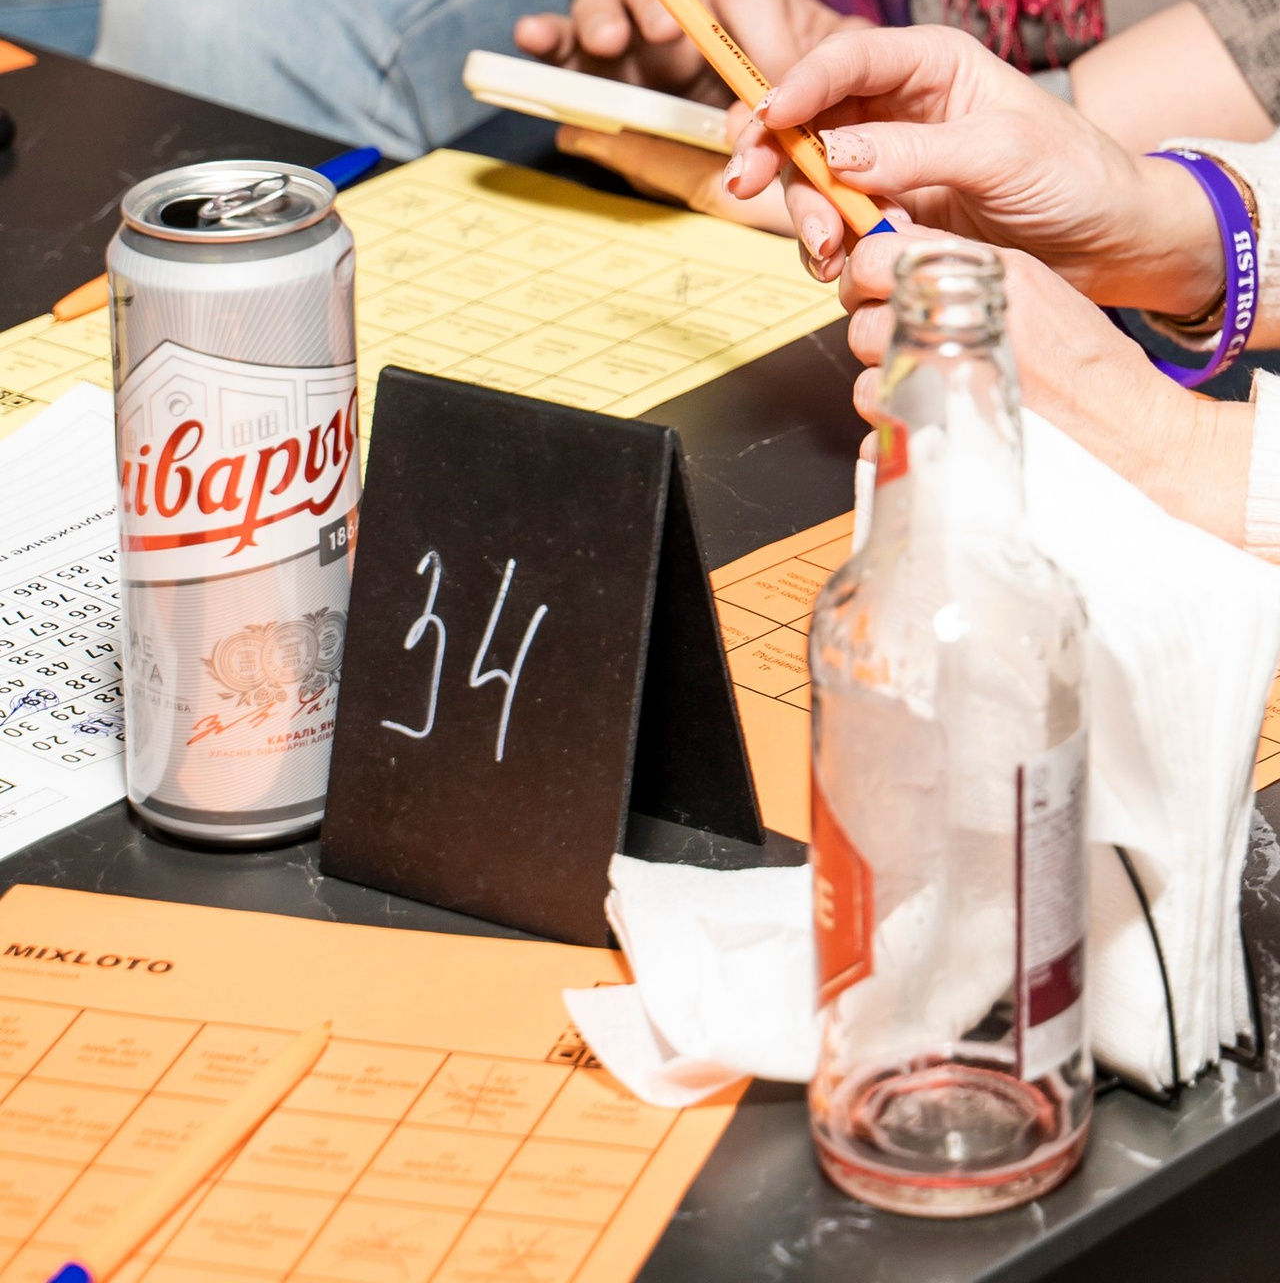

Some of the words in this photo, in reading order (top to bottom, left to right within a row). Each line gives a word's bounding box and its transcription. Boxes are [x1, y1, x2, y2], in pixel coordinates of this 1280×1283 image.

[1233, 230, 1256, 331] ASTRO
[328, 519, 358, 551] 186
[56, 565, 90, 580] 85
[13, 582, 47, 597] 86
[84, 576, 119, 591] 75
[41, 593, 76, 608] 76
[2, 610, 34, 626] 77
[69, 604, 102, 620] 66
[29, 621, 60, 637] 67
[57, 631, 89, 648] 57
[8, 649, 45, 665] 58
[84, 643, 115, 659] 47
[380, 550, 548, 763] 34
[36, 661, 70, 677] 48
[65, 673, 102, 690] 38
[50, 705, 86, 721] 29
[3, 721, 39, 738] 30
[32, 735, 68, 751] 20
[61, 748, 96, 763] 10
[3, 942, 175, 974] MIXLOTO
